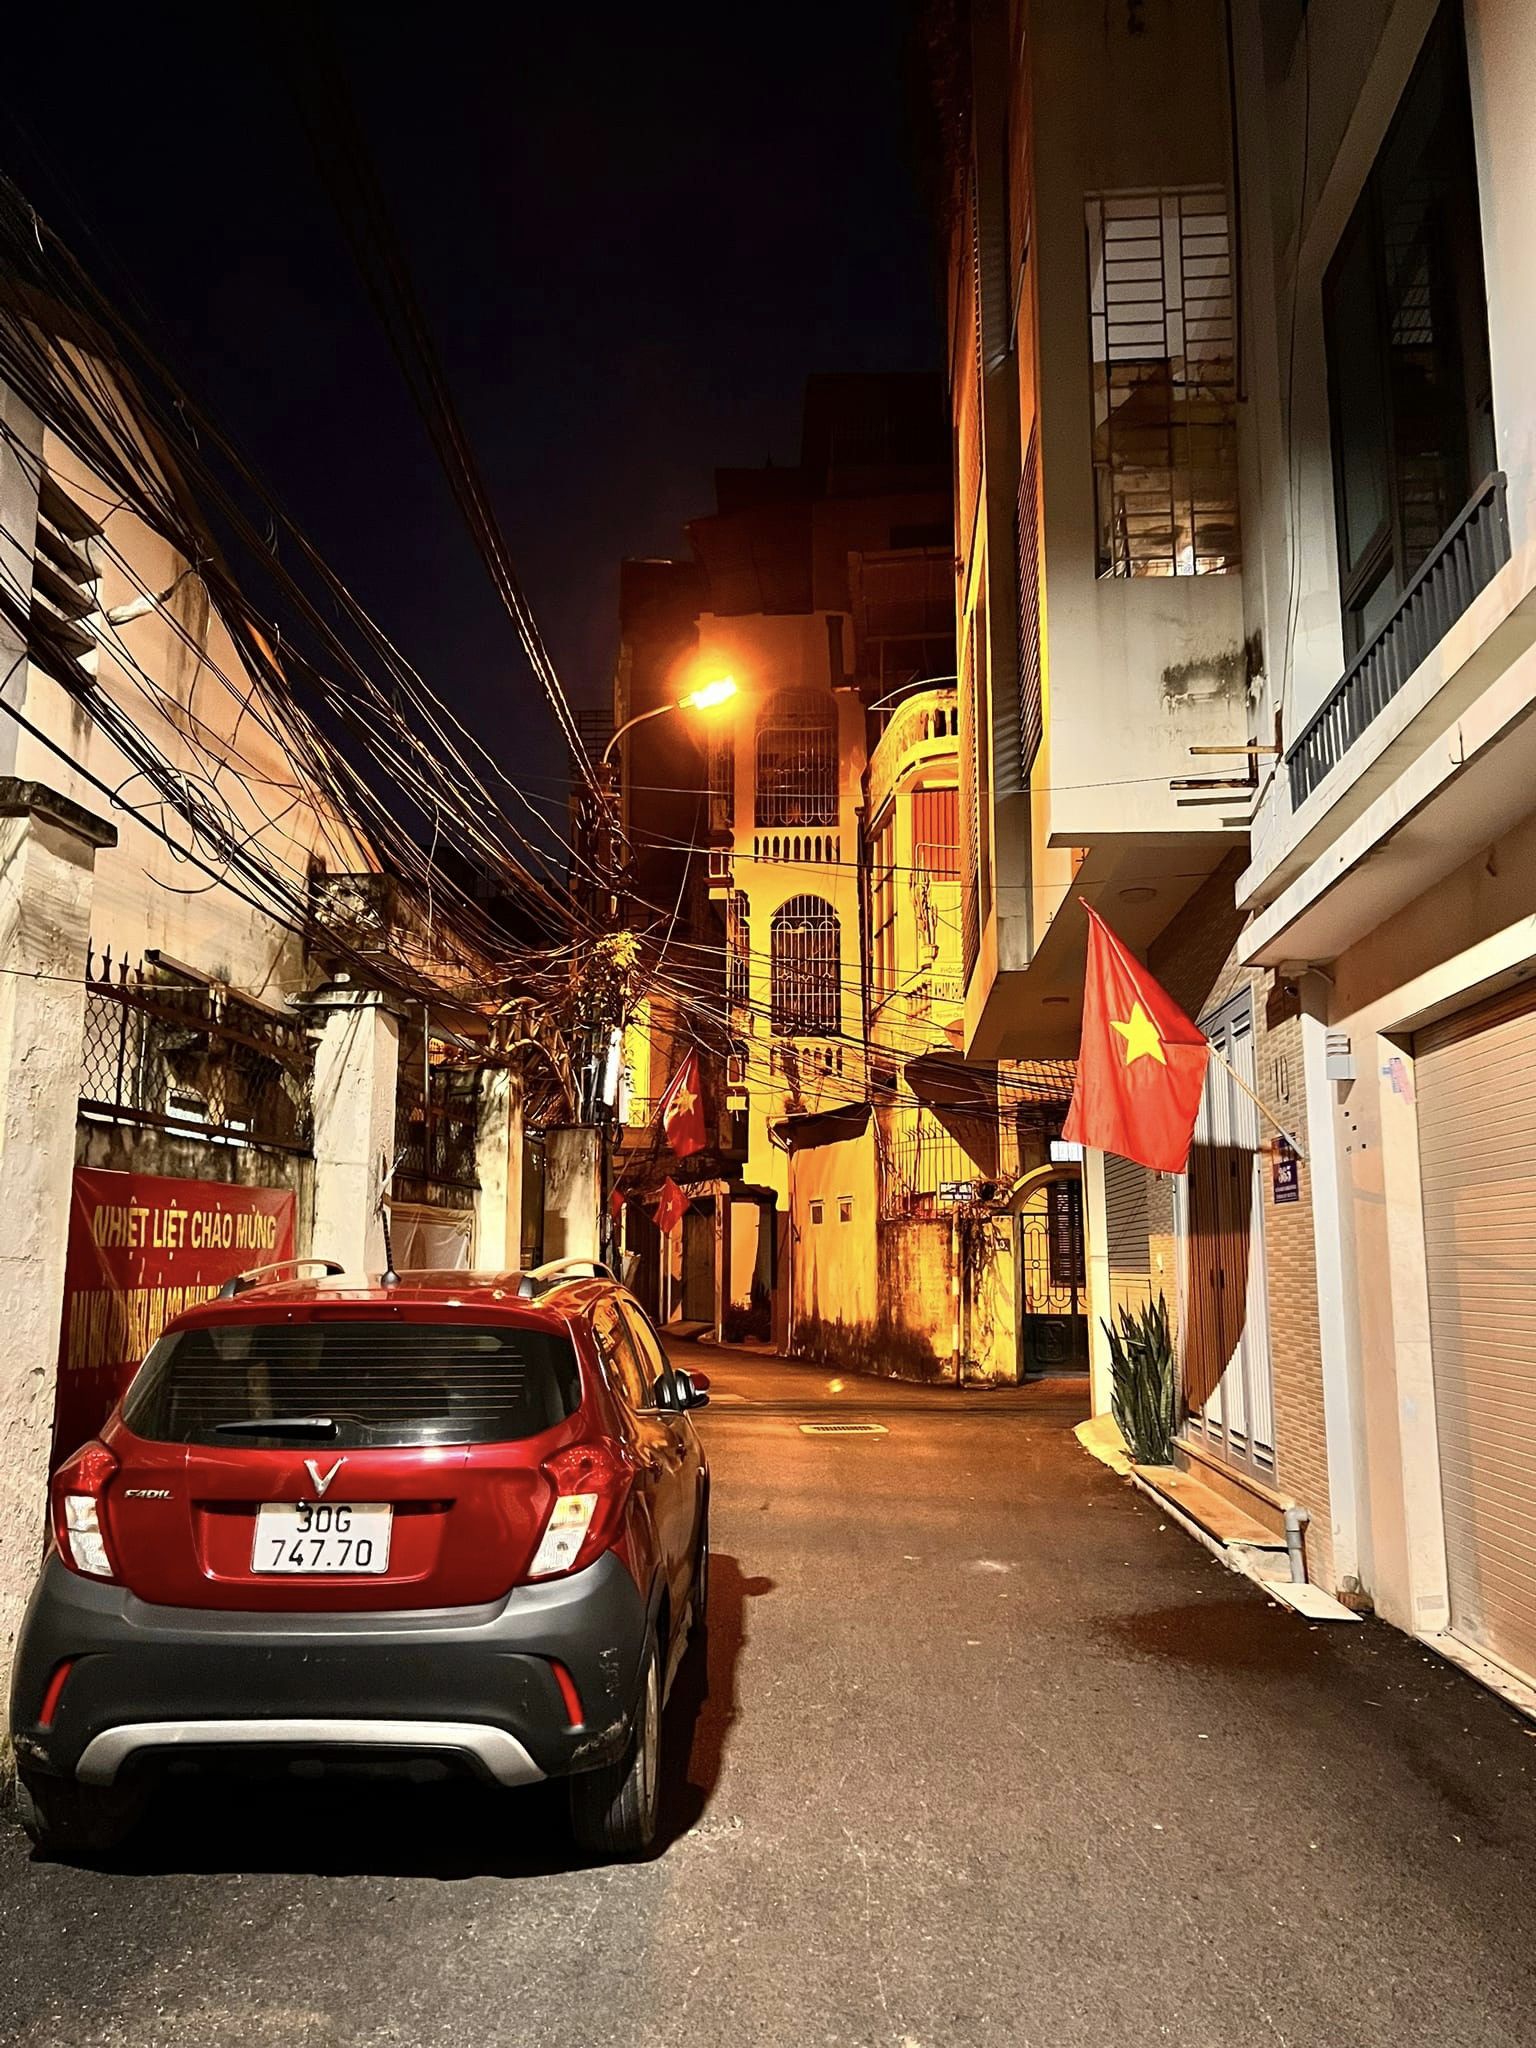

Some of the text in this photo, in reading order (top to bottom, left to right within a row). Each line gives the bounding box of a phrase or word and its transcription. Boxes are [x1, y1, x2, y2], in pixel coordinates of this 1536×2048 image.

[93, 1196, 277, 1260] NHIỆT LIỆT CHÀO MỪNG
[296, 1505, 353, 1534] 30G
[271, 1538, 374, 1568] 747.70
